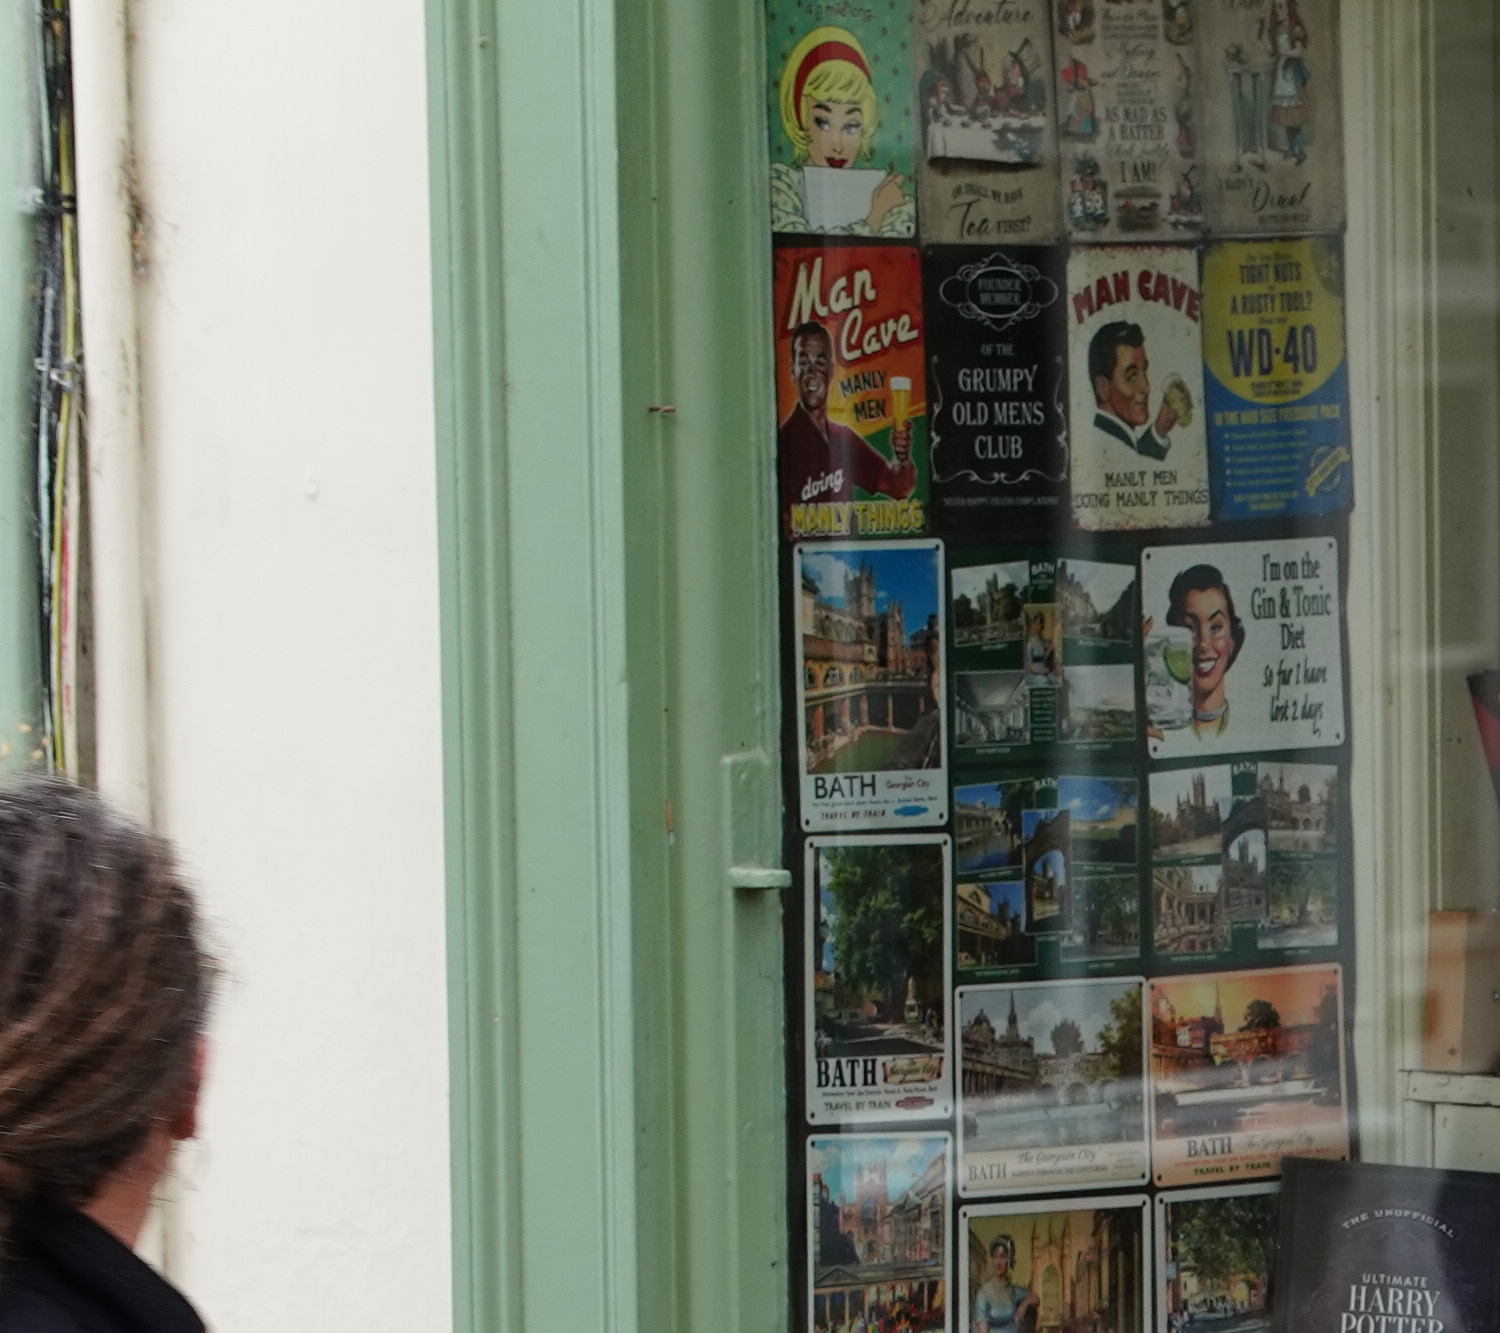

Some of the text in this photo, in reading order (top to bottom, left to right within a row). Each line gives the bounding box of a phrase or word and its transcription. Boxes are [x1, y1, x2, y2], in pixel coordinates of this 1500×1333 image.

[1072, 270, 1201, 323] MAN CAVE
[1227, 325, 1318, 378] WD-40
[958, 366, 1038, 395] GRUMPY
[952, 401, 1044, 428] OLD MENS
[974, 434, 1023, 460] CLUB
[814, 774, 877, 800] BATH
[1349, 1291, 1441, 1318] HARRY
